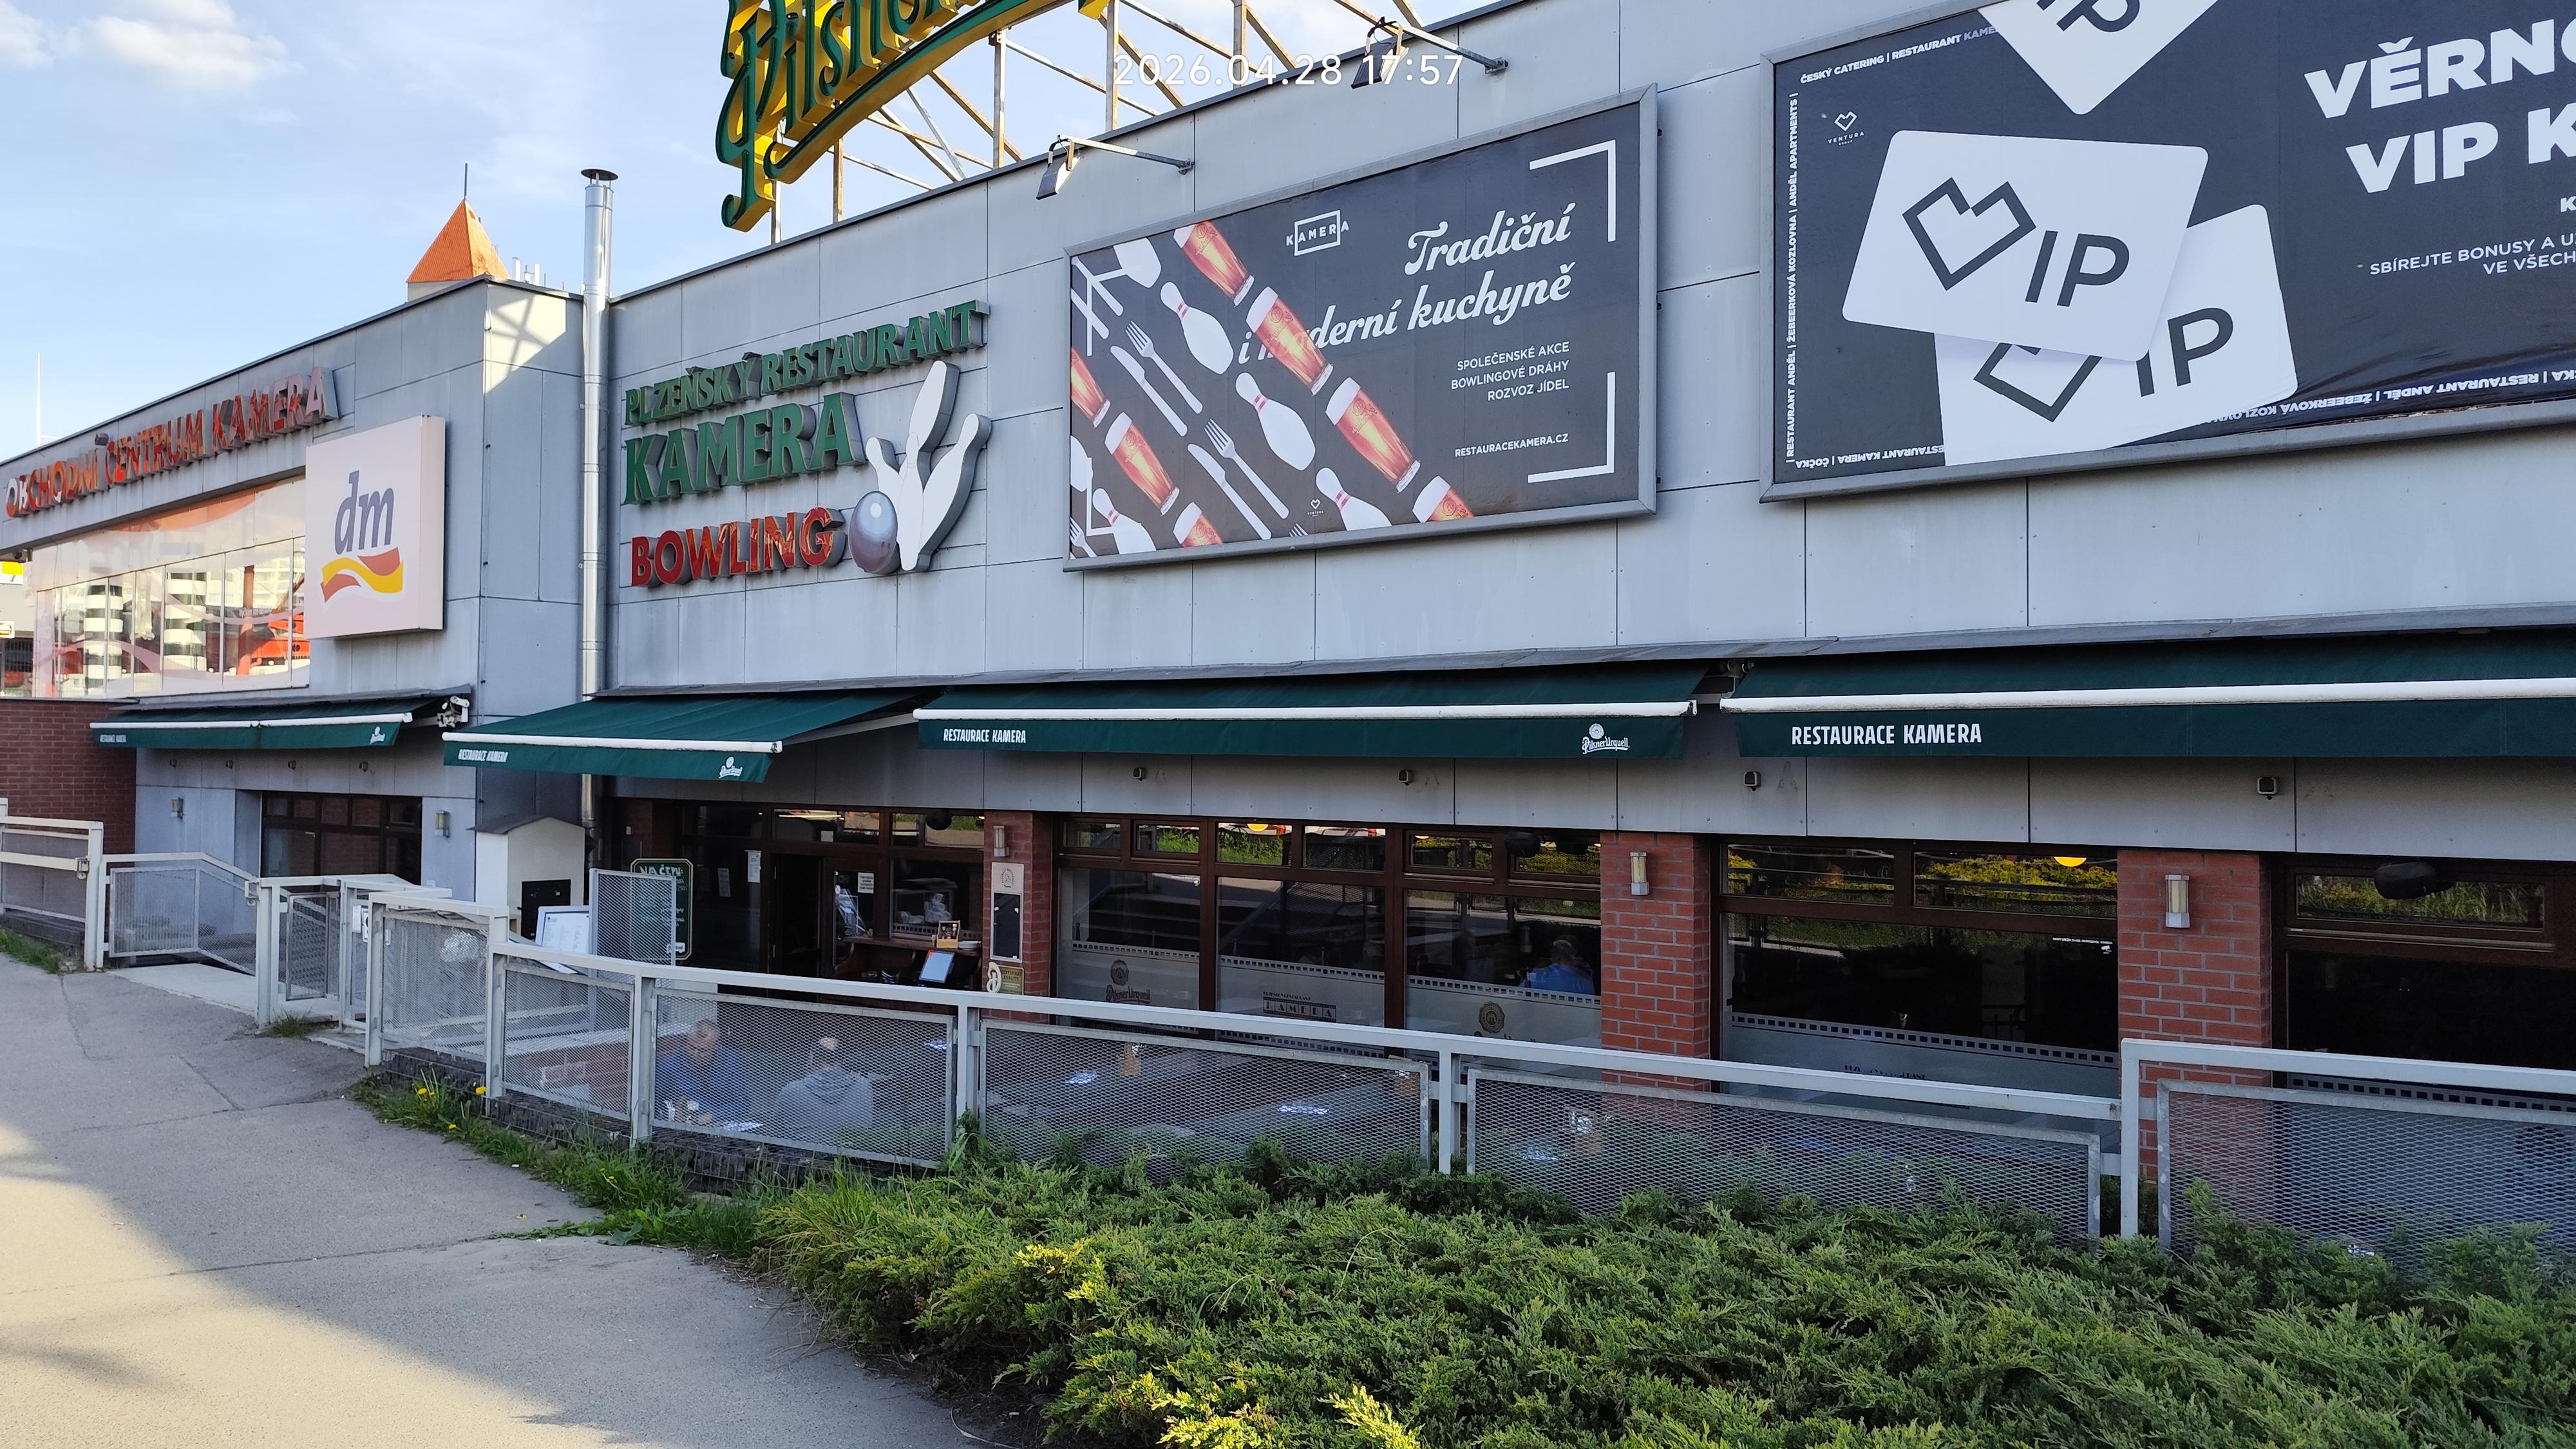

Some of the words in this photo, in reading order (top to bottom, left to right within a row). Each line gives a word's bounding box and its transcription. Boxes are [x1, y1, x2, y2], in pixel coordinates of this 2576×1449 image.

[1800, 66, 1832, 84] ČESKÝ
[1834, 54, 1885, 75] CATERING
[1891, 33, 1962, 60] RESTAURANT
[1964, 26, 1998, 41] KAME
[2304, 17, 2576, 118] VĚRN
[1789, 99, 1798, 169] APARTMENTS
[1828, 131, 1864, 144] VENTURA
[2345, 121, 2499, 193] VIP
[1788, 171, 1797, 207] ANDĚL
[1286, 220, 1350, 247] KAMERA
[1405, 202, 1576, 275] Tradiční
[1788, 214, 1797, 272] KOZLOVNA
[2370, 251, 2452, 275] SBÍREJTE
[2458, 238, 2536, 262] BONUSY
[2541, 236, 2555, 250] A
[2561, 232, 2576, 247] U
[2483, 260, 2508, 275] VE
[1238, 331, 1251, 365] i
[1407, 261, 1577, 326] kuchyně
[1786, 273, 1797, 343] ŽEBEERKOVÁ
[625, 352, 762, 426] PLZEŇSKÝ
[762, 300, 989, 395] RESTAURANT
[1457, 345, 1535, 371] SPOLEČENSKÉ
[1538, 341, 1570, 357] AKCE
[1786, 350, 1795, 386] ANDĚL
[1451, 365, 1526, 390] BOWLINGOVÉ
[1528, 359, 1570, 377] DRÁHY
[1488, 384, 1535, 401] ROZVOZ
[1537, 379, 1569, 393] JÍDEL
[2436, 373, 2539, 393] RESTAURANT
[2551, 369, 2576, 382] KA
[2280, 392, 2372, 414] ŽEBEERKOVÁ
[2382, 383, 2432, 400] ANDĚL
[1786, 388, 1795, 458] RESTAURANT
[2206, 406, 2278, 423] KOZLOV
[6, 434, 108, 517] OBCHODNÍ
[105, 409, 207, 486] CENTRUM
[212, 366, 338, 452] KAMERA
[624, 392, 867, 505] KAMERA
[1454, 433, 1569, 457] RESTAURACEKAMERA.CZ
[1882, 444, 1945, 459] ESTAURANT
[1795, 457, 1830, 469] ČOČKA
[1837, 451, 1880, 464] KAMERA
[334, 470, 395, 555] dm
[631, 507, 846, 587] BOWLING
[943, 728, 990, 743] RESTAURACE
[992, 729, 1027, 743] KAMERA
[1582, 736, 1606, 754] Pilsner
[1605, 735, 1630, 752] Urquell
[1791, 724, 1895, 745] RESTAURACE
[1903, 723, 1982, 744] KAMERA
